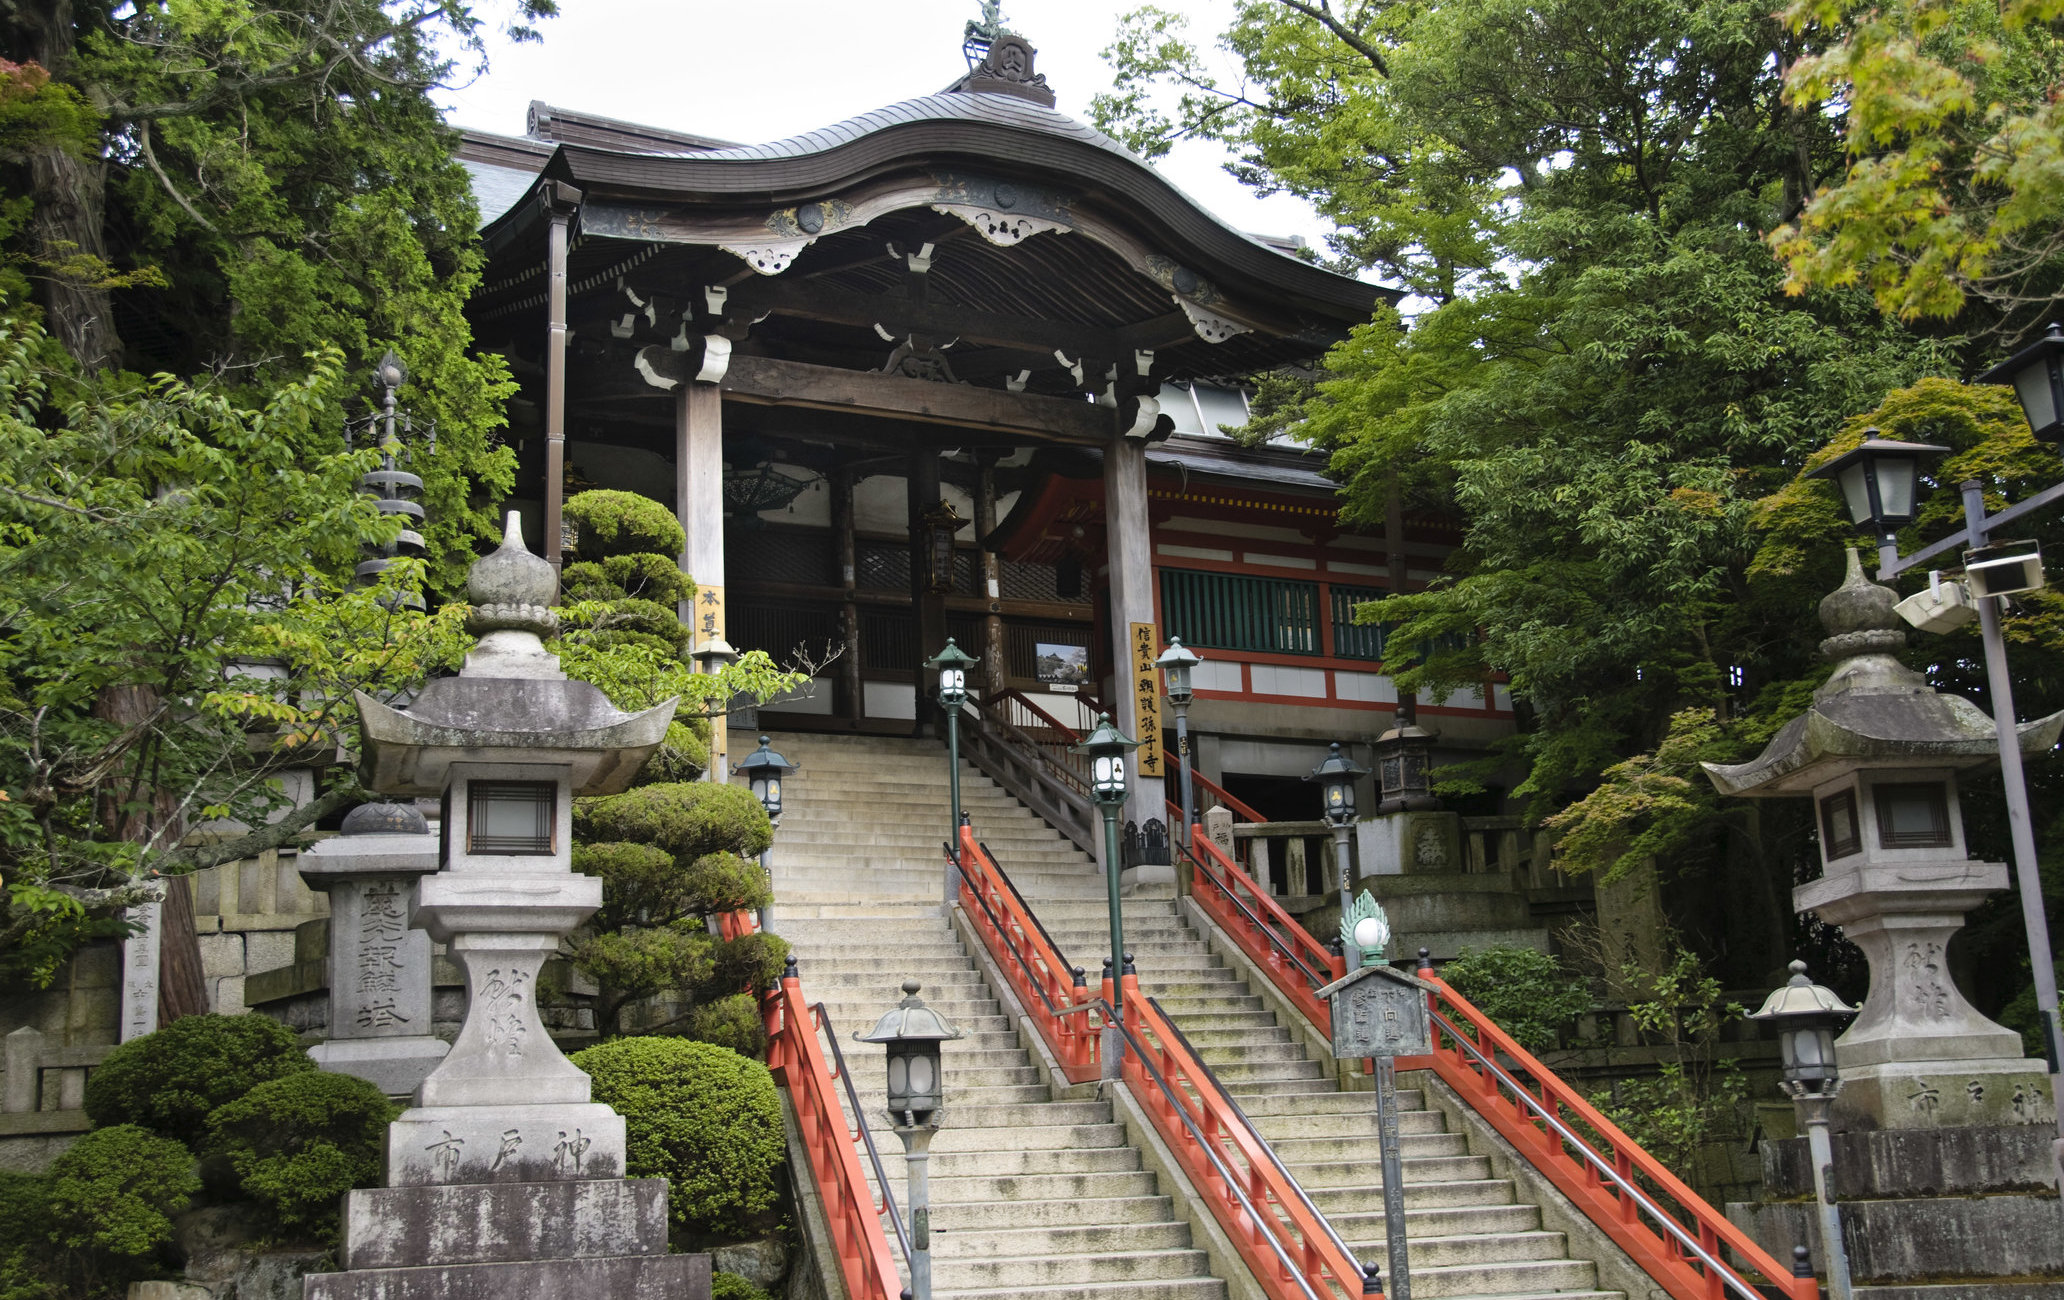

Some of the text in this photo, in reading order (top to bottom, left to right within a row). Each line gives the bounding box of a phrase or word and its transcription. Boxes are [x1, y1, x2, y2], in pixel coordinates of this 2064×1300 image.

[1137, 627, 1159, 773] 信貴山朝護孫子寺
[425, 1128, 591, 1184] 神戸市
